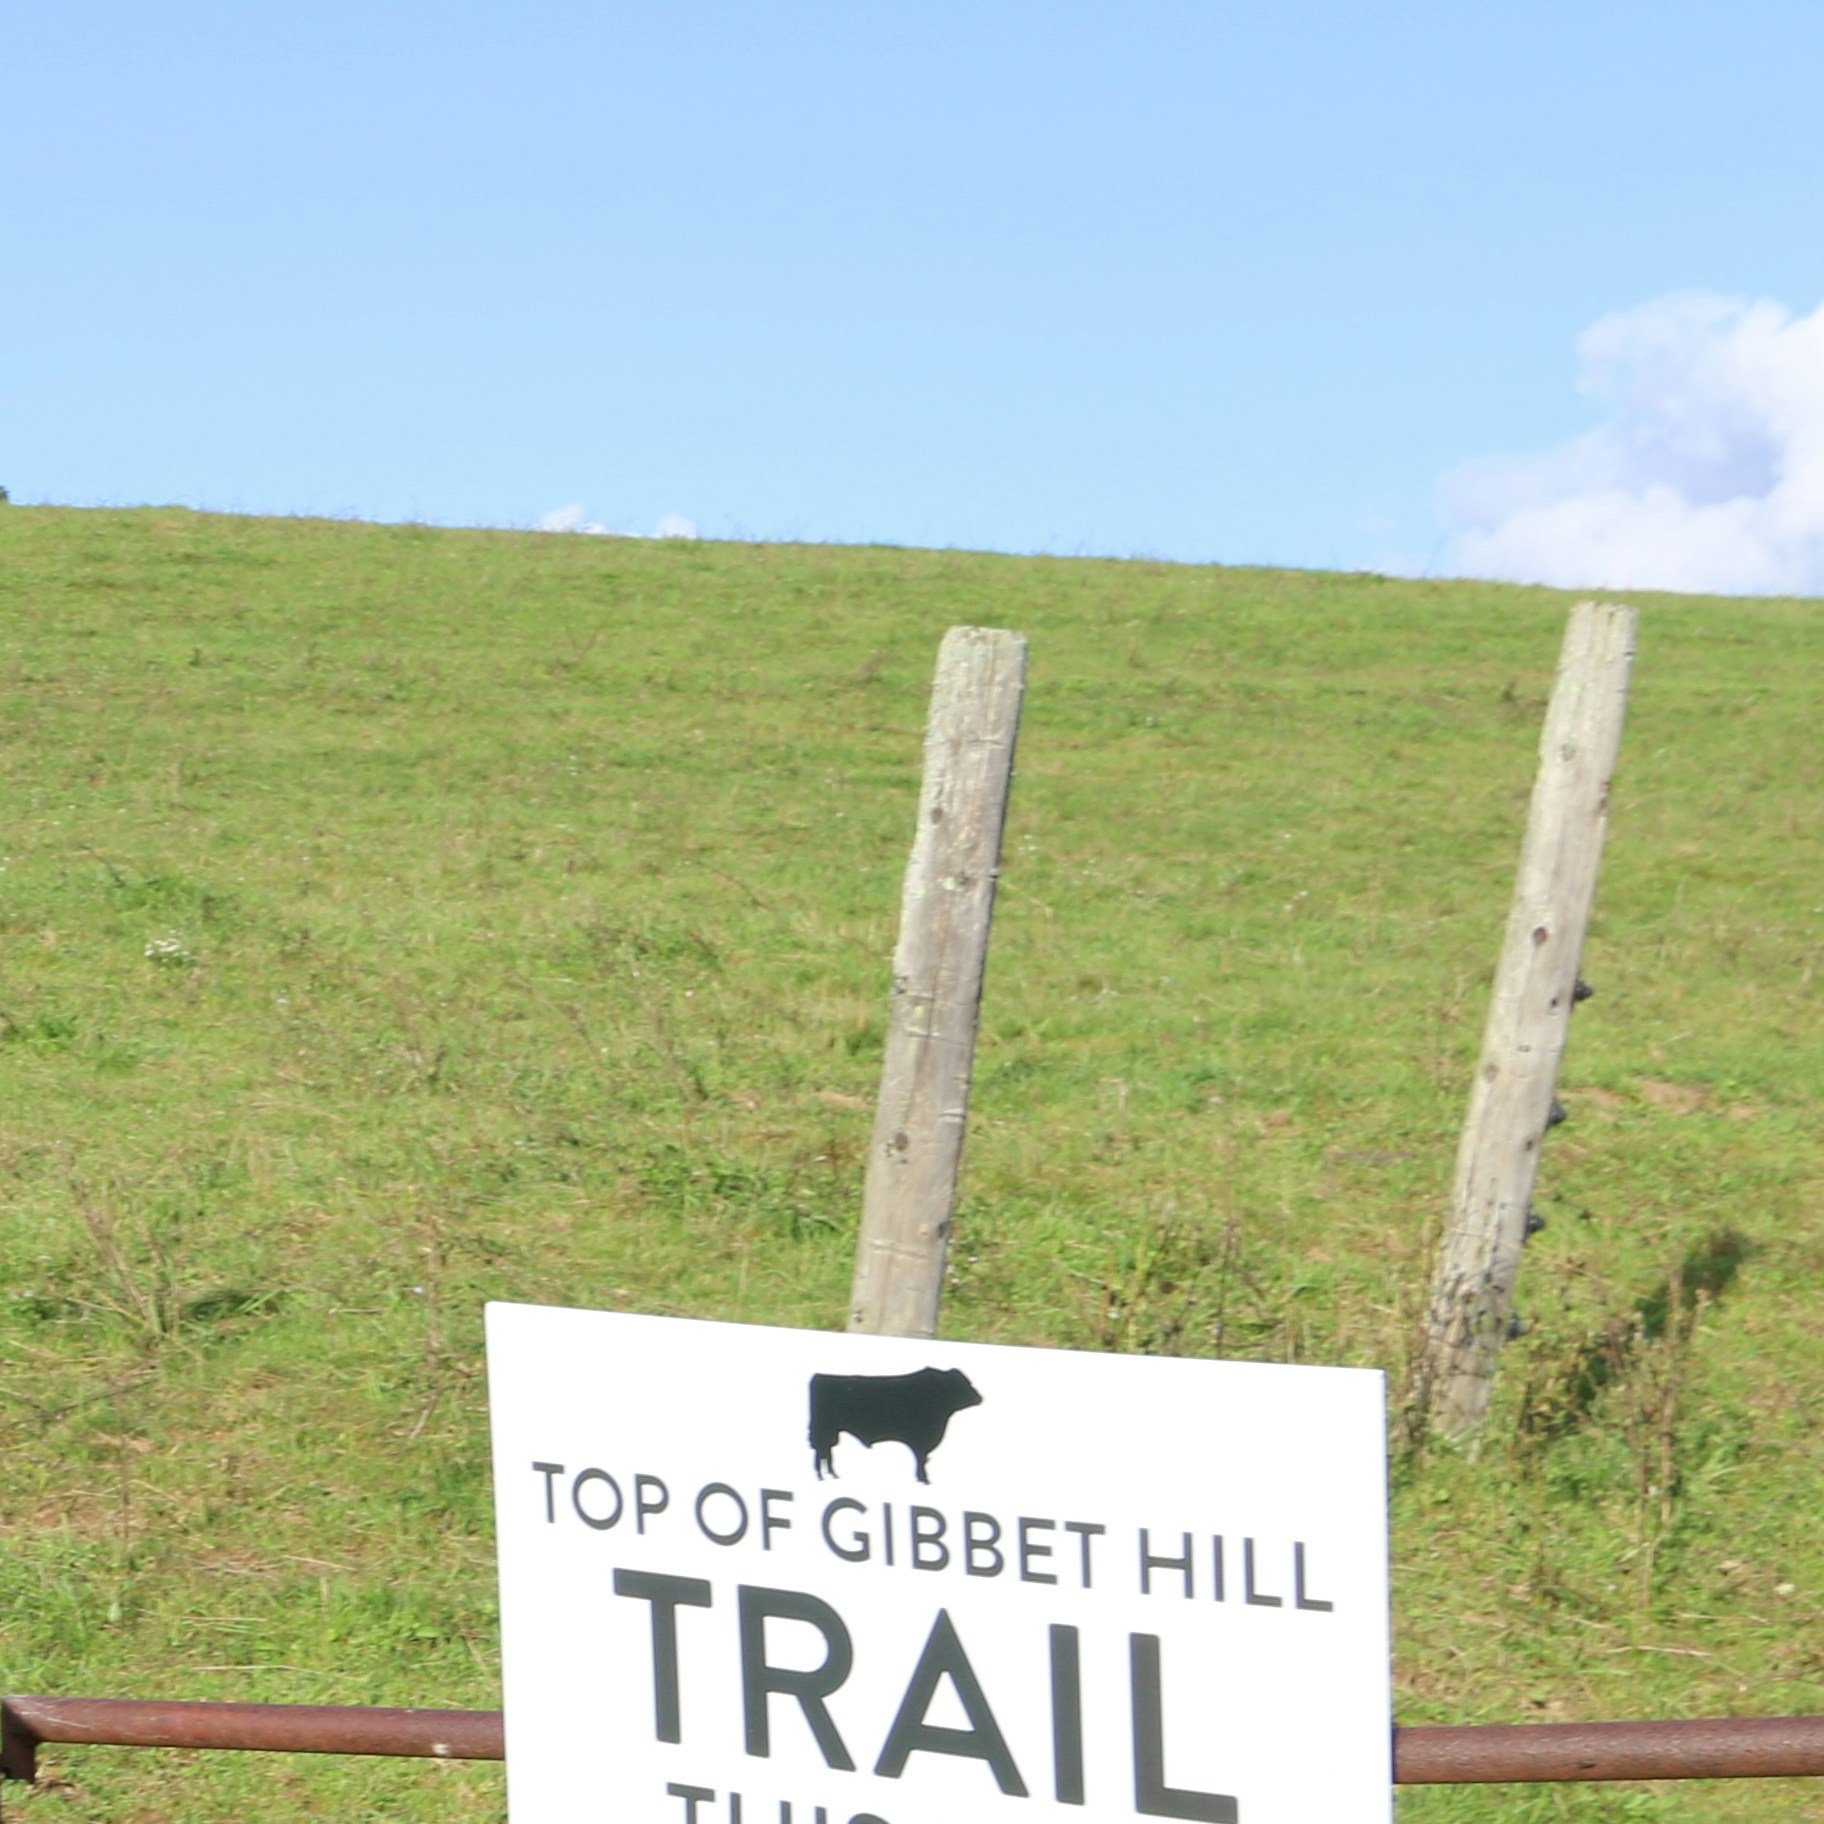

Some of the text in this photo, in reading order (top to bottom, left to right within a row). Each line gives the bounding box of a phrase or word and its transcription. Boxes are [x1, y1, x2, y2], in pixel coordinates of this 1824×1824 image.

[532, 1461, 1333, 1612] TOP OF GIBBET HILL
